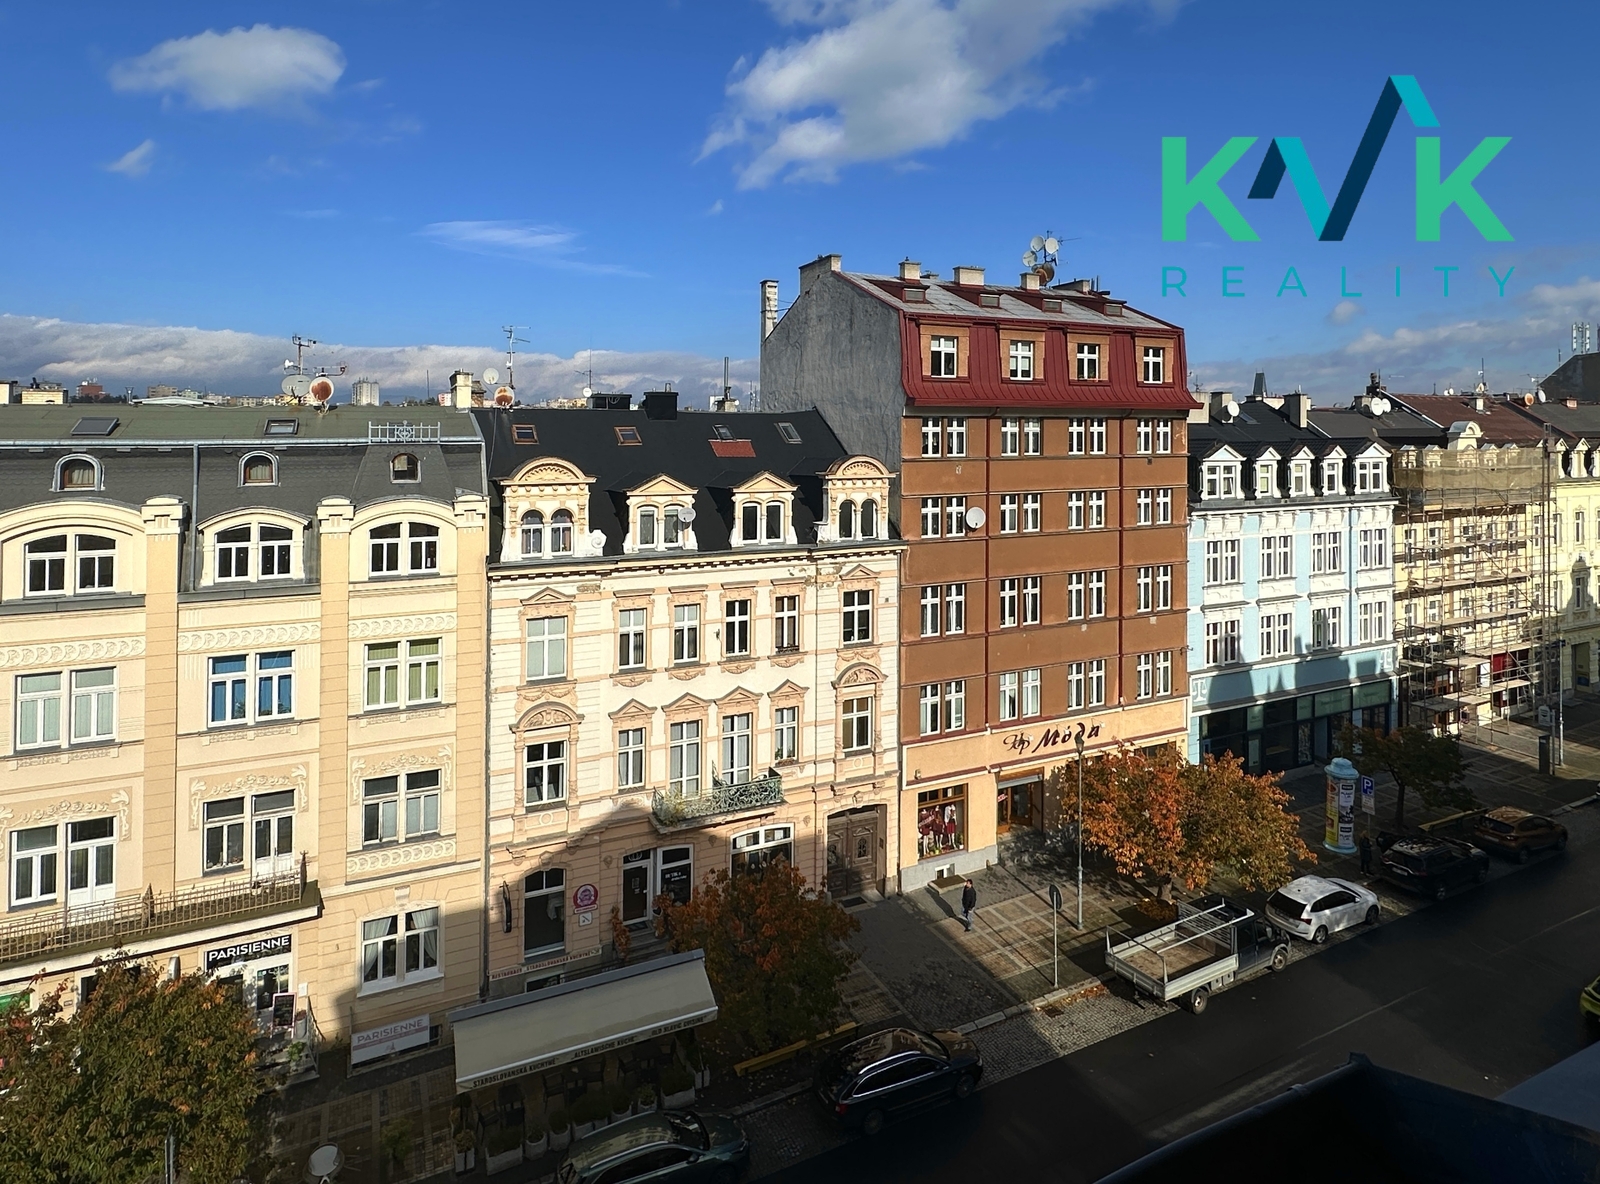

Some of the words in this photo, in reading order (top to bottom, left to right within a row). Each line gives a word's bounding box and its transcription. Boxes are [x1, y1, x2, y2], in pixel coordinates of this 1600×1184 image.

[1363, 779, 1372, 790] P
[208, 936, 290, 962] PARISIENNE
[357, 1018, 424, 1043] PARISIENNE
